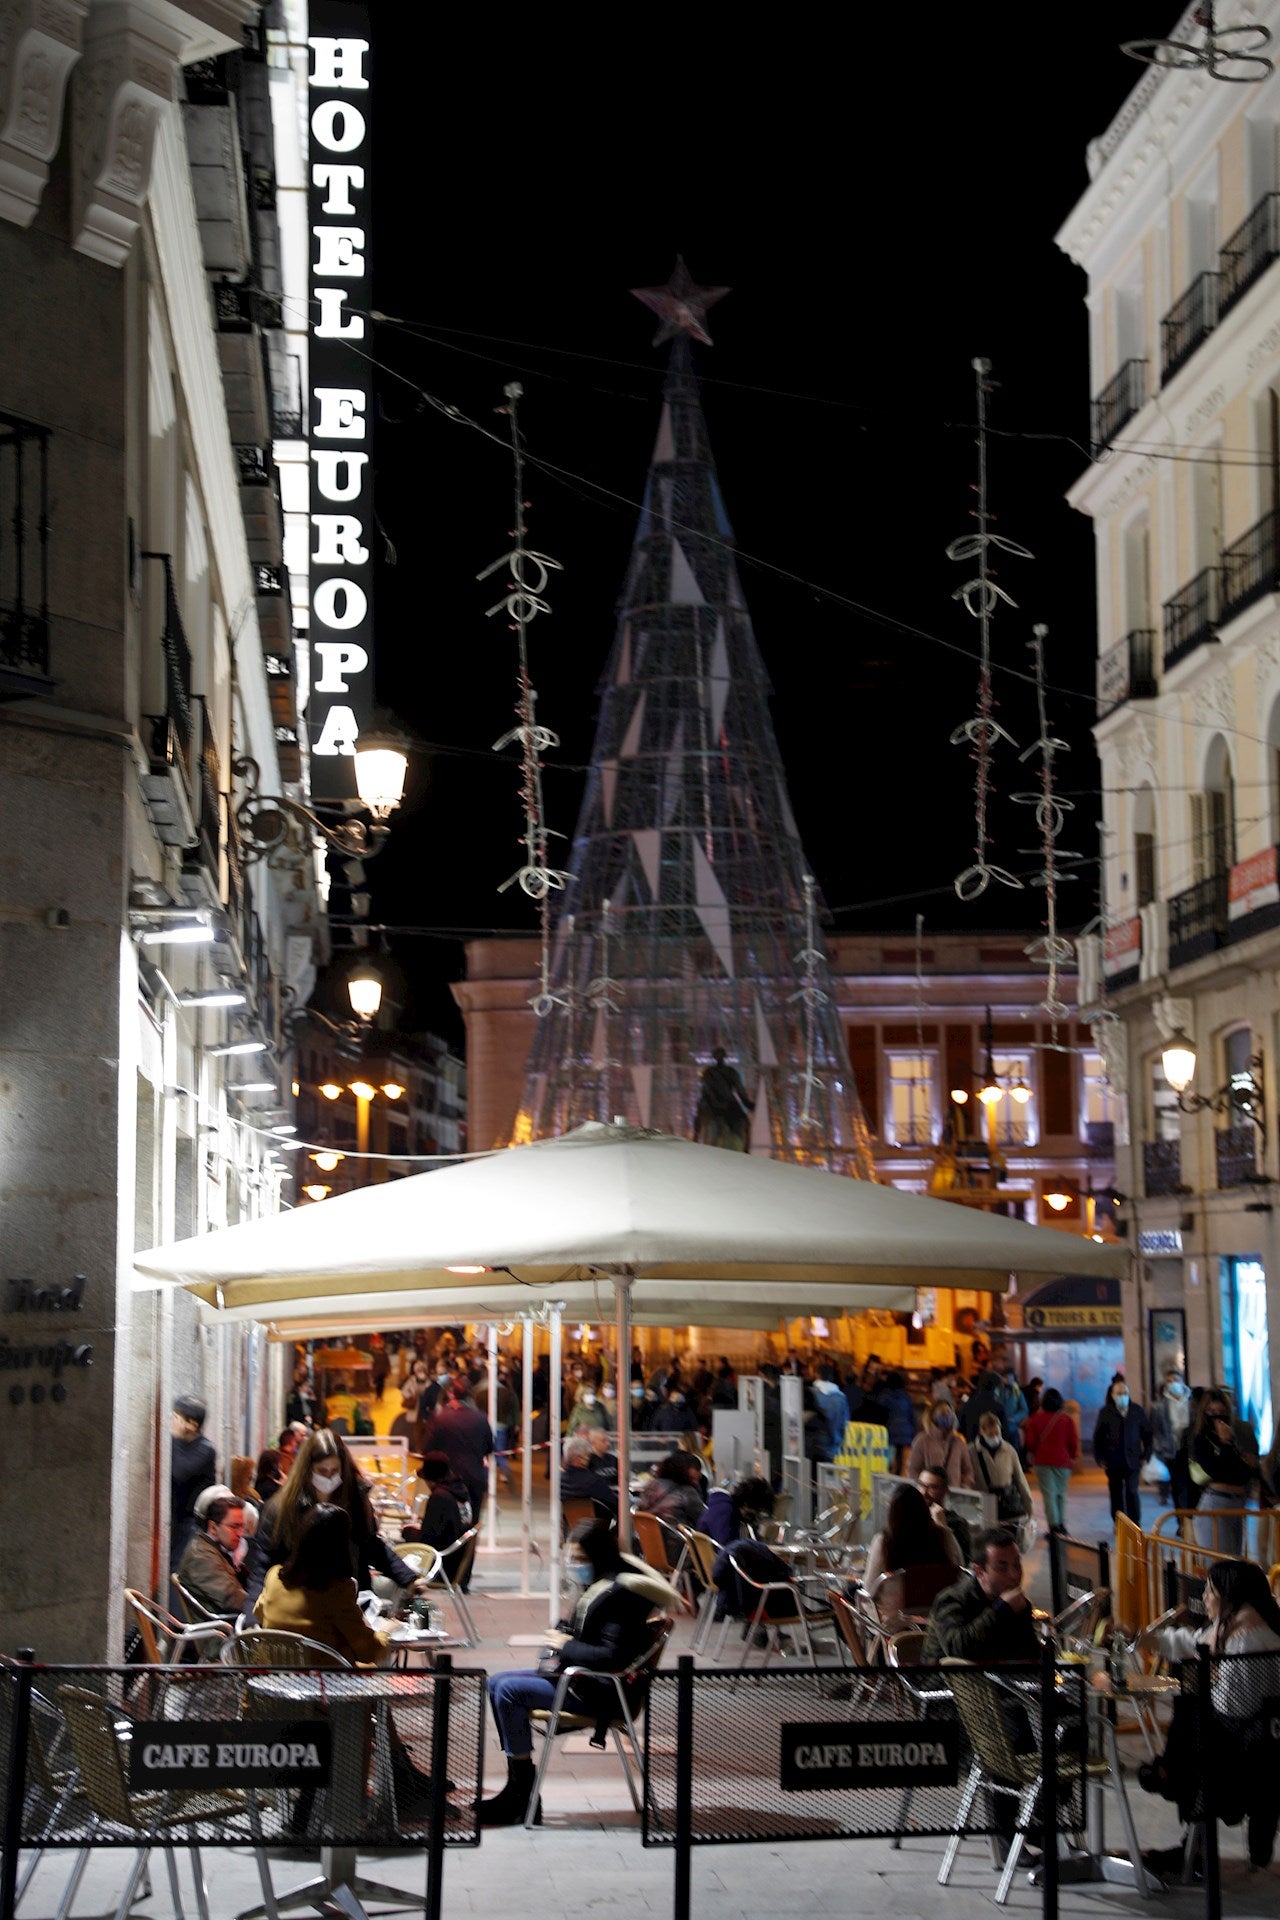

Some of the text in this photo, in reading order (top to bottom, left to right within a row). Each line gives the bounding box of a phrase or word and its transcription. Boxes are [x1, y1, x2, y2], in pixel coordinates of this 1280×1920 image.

[308, 36, 370, 757] HOTEL EUROPA
[142, 1743, 322, 1769] CAFE EUROPA
[794, 1742, 948, 1769] CAFE EUROPA
